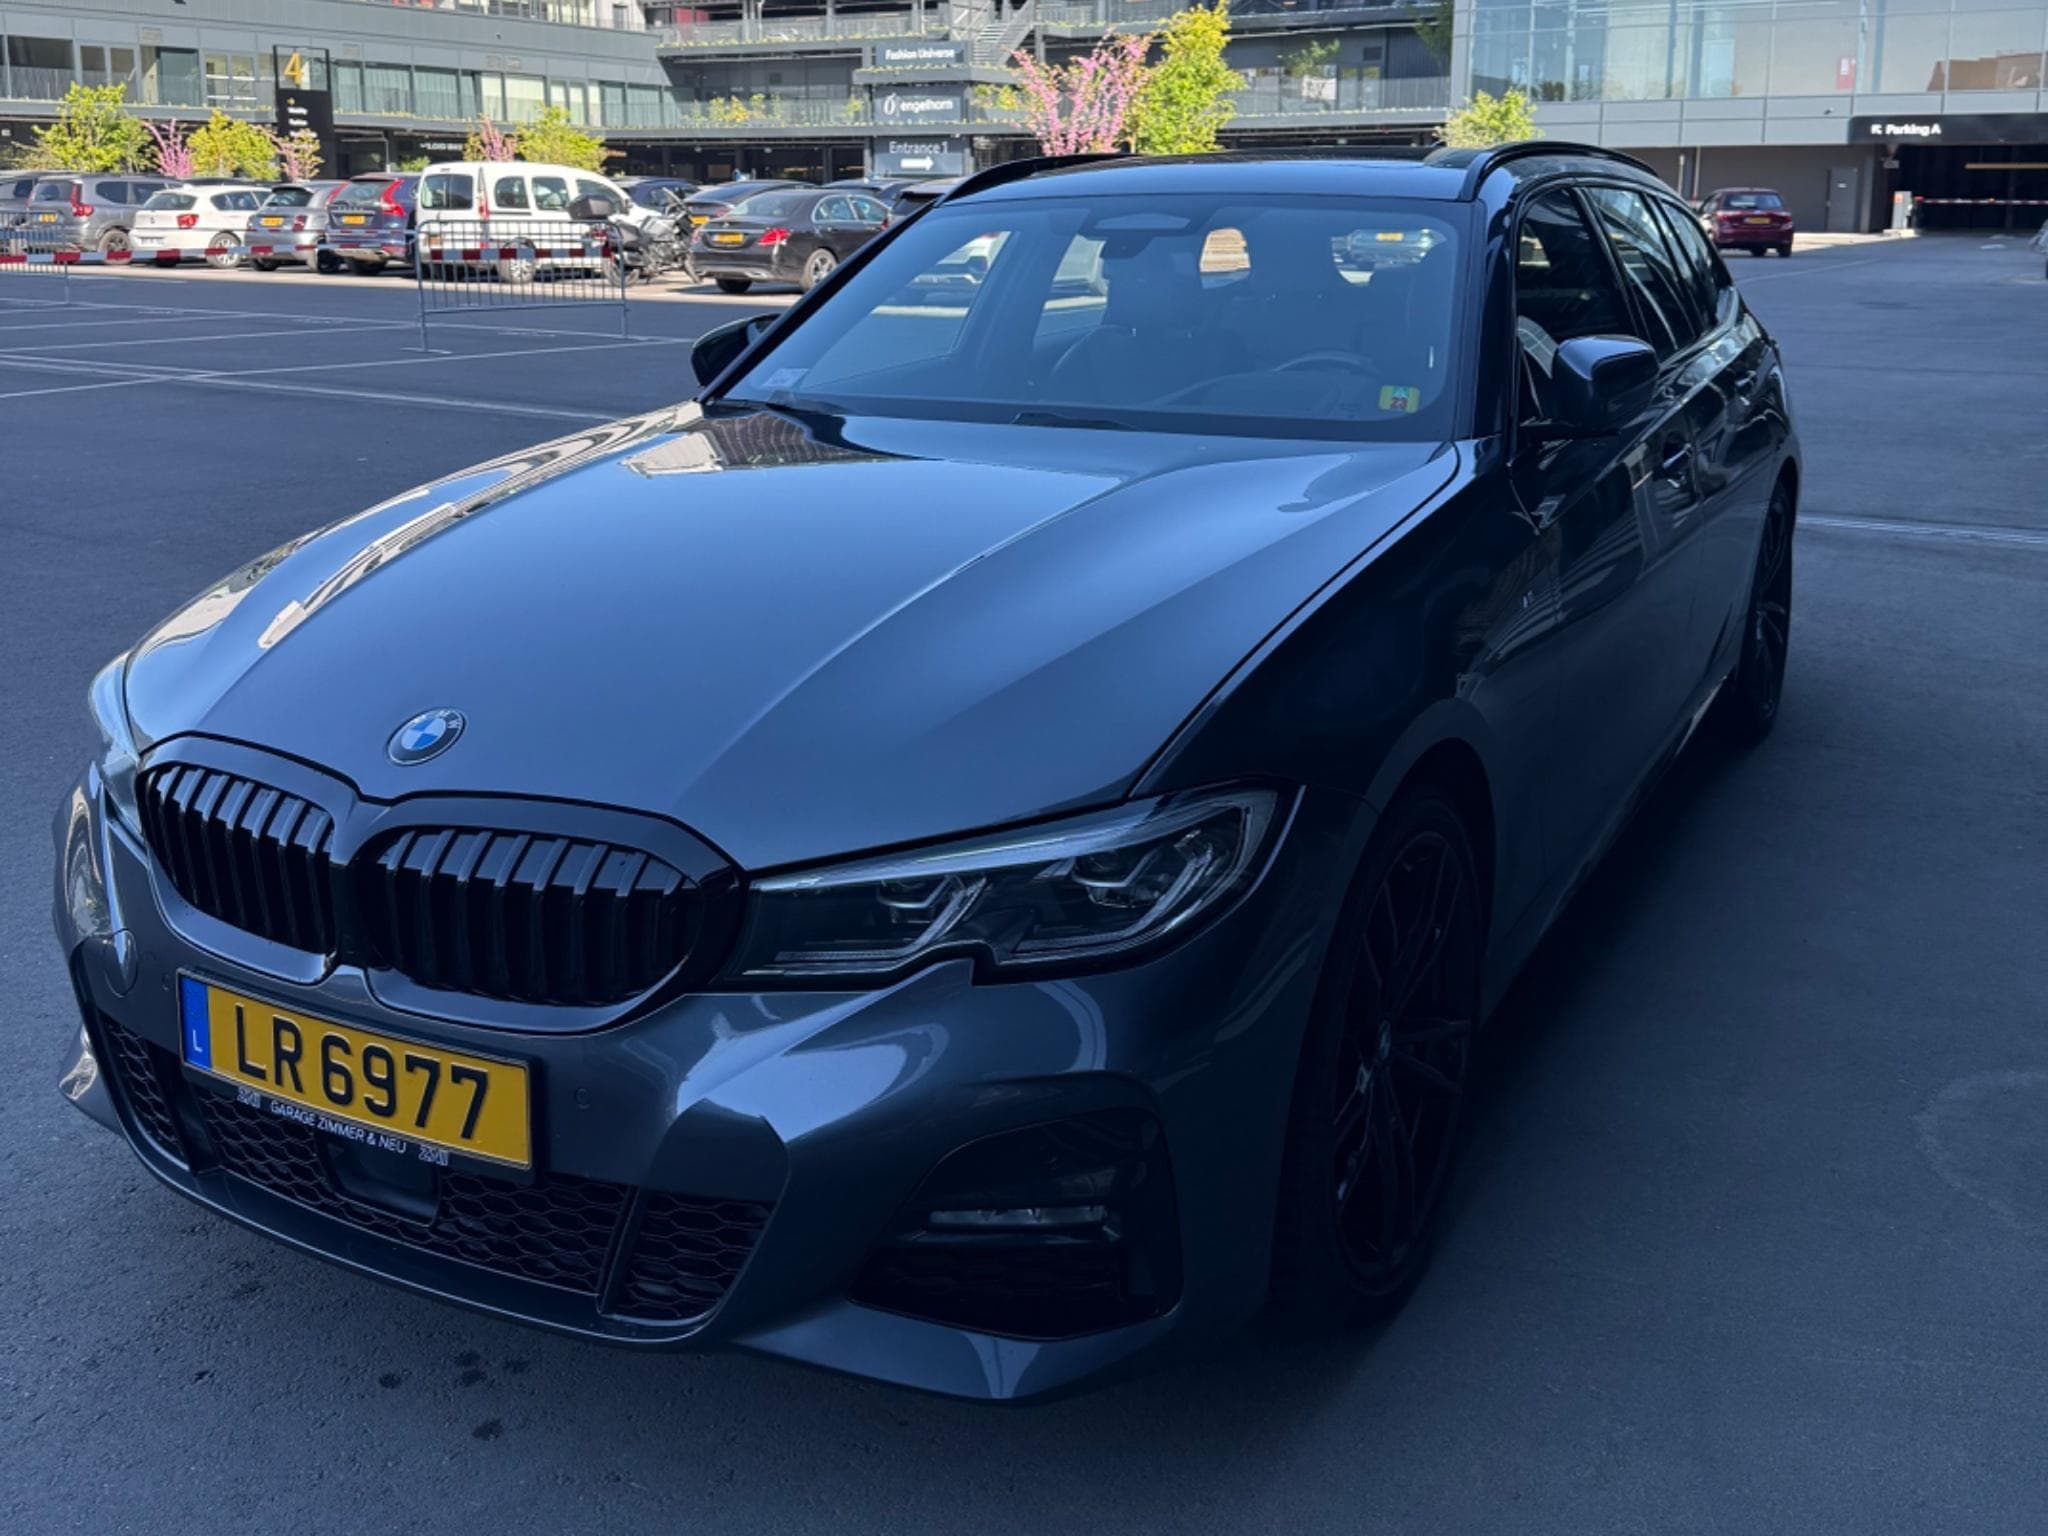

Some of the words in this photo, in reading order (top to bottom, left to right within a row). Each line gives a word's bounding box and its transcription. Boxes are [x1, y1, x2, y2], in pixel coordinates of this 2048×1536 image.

[885, 49, 917, 60] Fashion
[284, 53, 303, 87] 4
[900, 99, 953, 113] engelhorn
[1886, 124, 1930, 136] Parking
[1931, 123, 1942, 134] A
[889, 141, 941, 154] Entrance
[941, 141, 948, 154] 1
[192, 1029, 203, 1053] L
[235, 1002, 304, 1094] LR
[320, 1031, 489, 1140] 6977
[270, 1100, 316, 1127] GARAGE
[316, 1117, 365, 1144] ZIMMER
[365, 1132, 377, 1146] &
[378, 1135, 407, 1154] NEU
